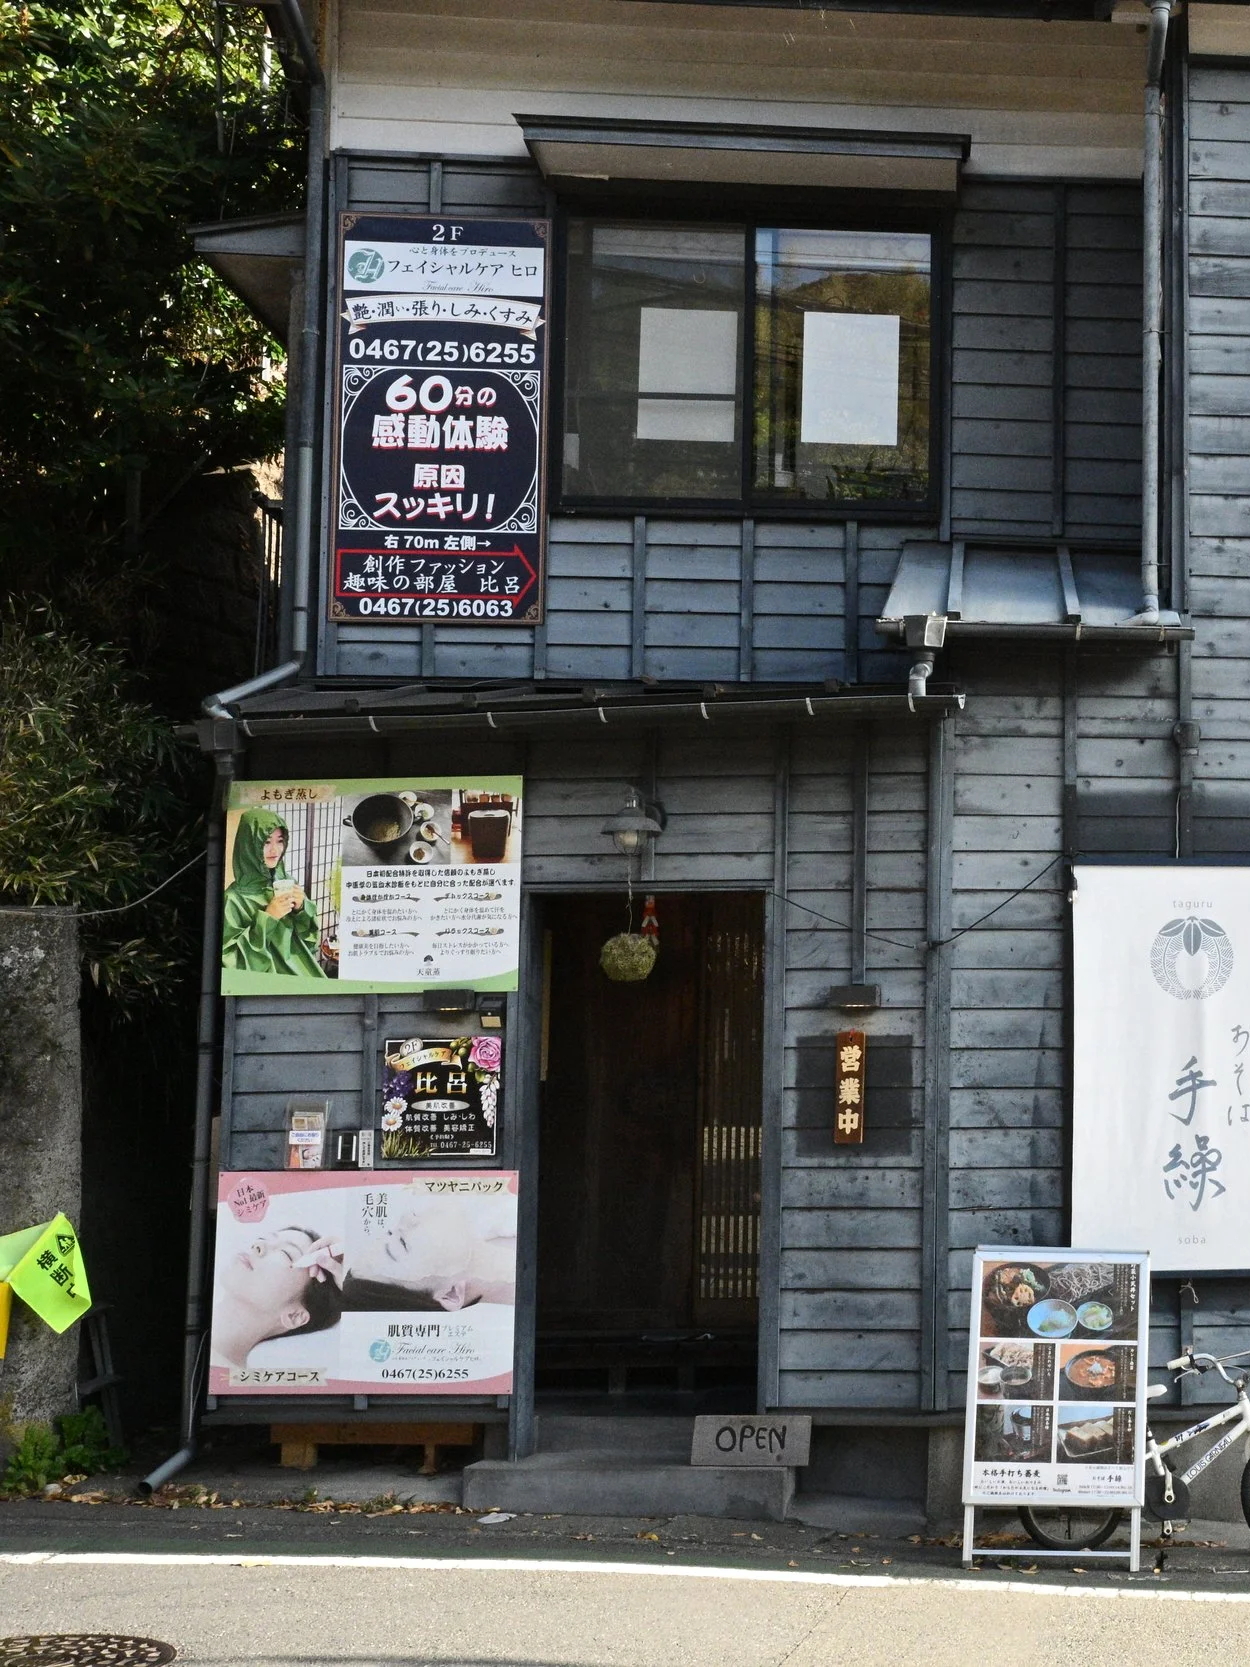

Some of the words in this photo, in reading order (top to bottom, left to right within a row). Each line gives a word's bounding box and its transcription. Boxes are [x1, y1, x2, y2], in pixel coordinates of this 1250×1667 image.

[409, 245, 517, 258] 心と身体をプロデュース
[387, 259, 504, 277] フェイシャルケア
[511, 264, 538, 277] ヒロ
[350, 338, 536, 364] 0467(25)6255
[385, 374, 497, 413] 60分の
[372, 413, 509, 450] 感動体験
[413, 463, 466, 490] 原因
[362, 554, 506, 575] 創作ファッション
[342, 572, 459, 594] 趣味の部屋
[479, 574, 520, 595] 比呂
[358, 597, 513, 617] 0467(25)6063
[260, 787, 318, 801] よもぎ蒸し
[1172, 899, 1213, 909] taguru
[404, 1041, 420, 1055] 2F
[414, 1071, 468, 1094] 比呂
[838, 1044, 862, 1135] 営業中
[405, 1112, 438, 1121] 肌質改善
[404, 1123, 438, 1133] 体質改善
[1162, 1055, 1227, 1212] 手繰
[1177, 1234, 1207, 1245] soba
[387, 1324, 441, 1338] 肌質専門
[240, 1370, 321, 1383] シミケアコース
[381, 1368, 470, 1380] 0467(25)6255
[715, 1425, 787, 1453] OPEN
[1186, 1459, 1207, 1480] LOUIS
